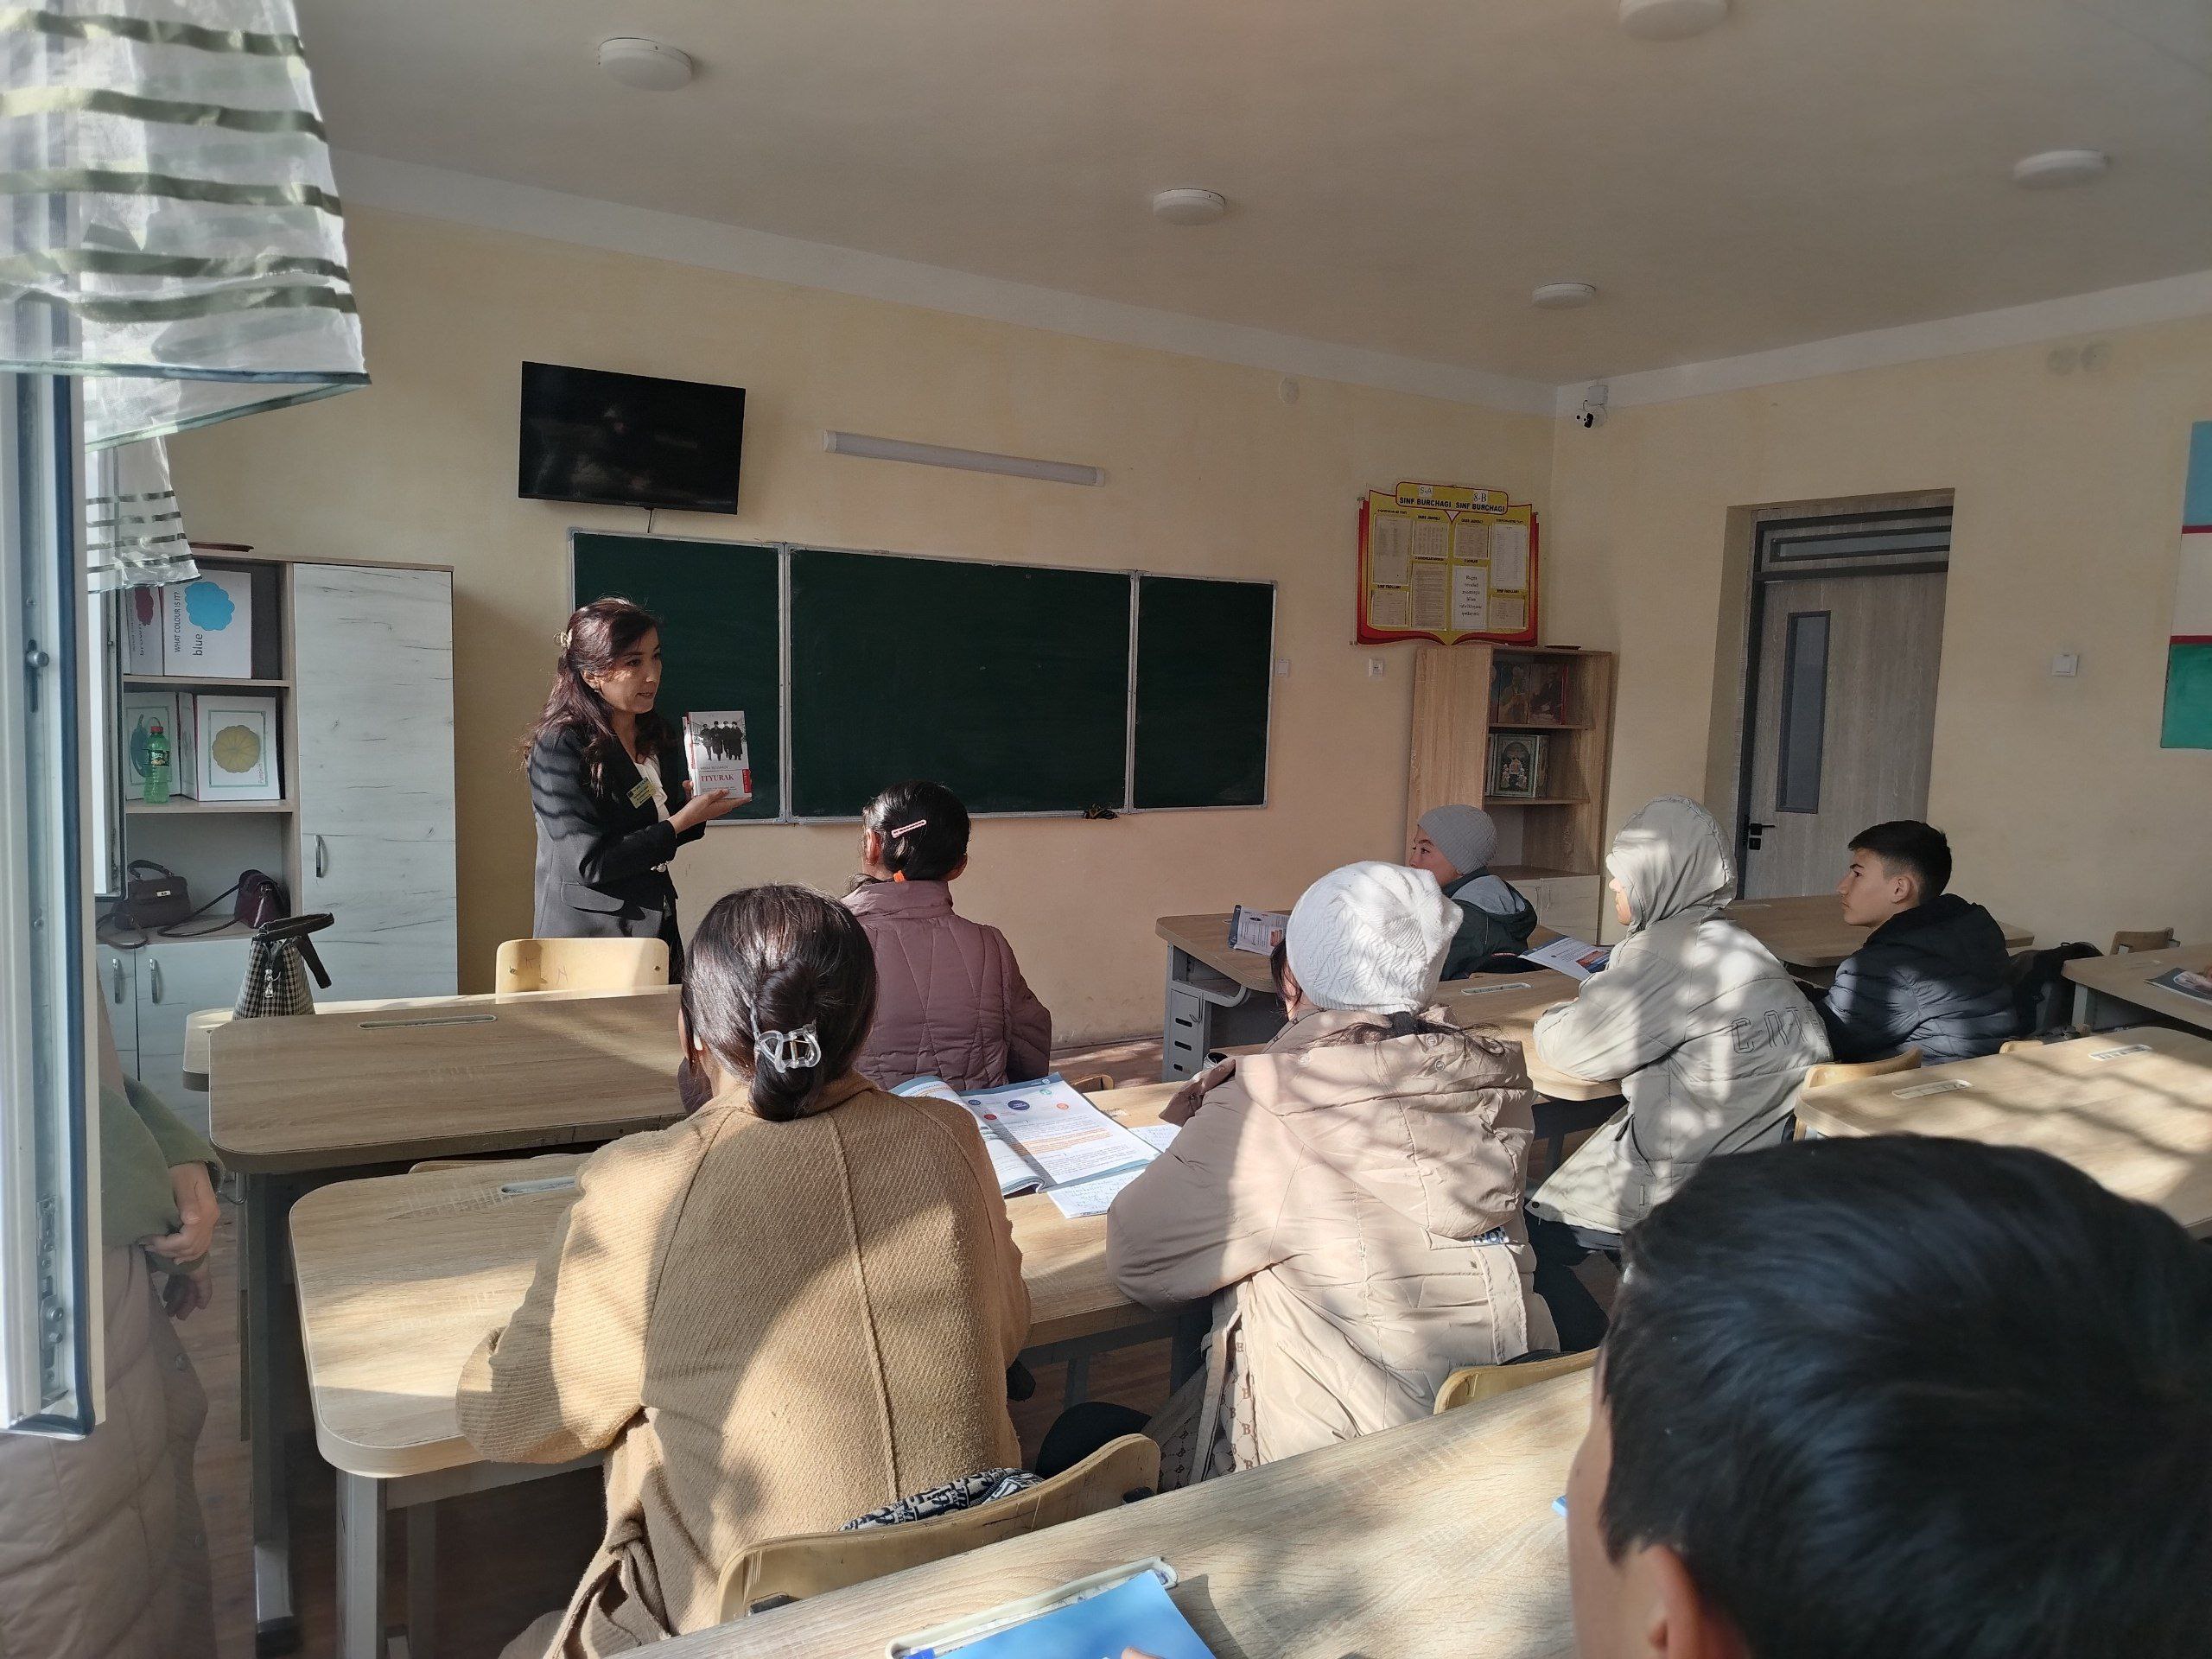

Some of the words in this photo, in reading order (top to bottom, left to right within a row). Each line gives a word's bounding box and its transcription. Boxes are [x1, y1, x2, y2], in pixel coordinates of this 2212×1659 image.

[1416, 499, 1452, 508] BURCHAGI
[1472, 504, 1505, 513] BURCHAGI
[192, 633, 203, 656] blue
